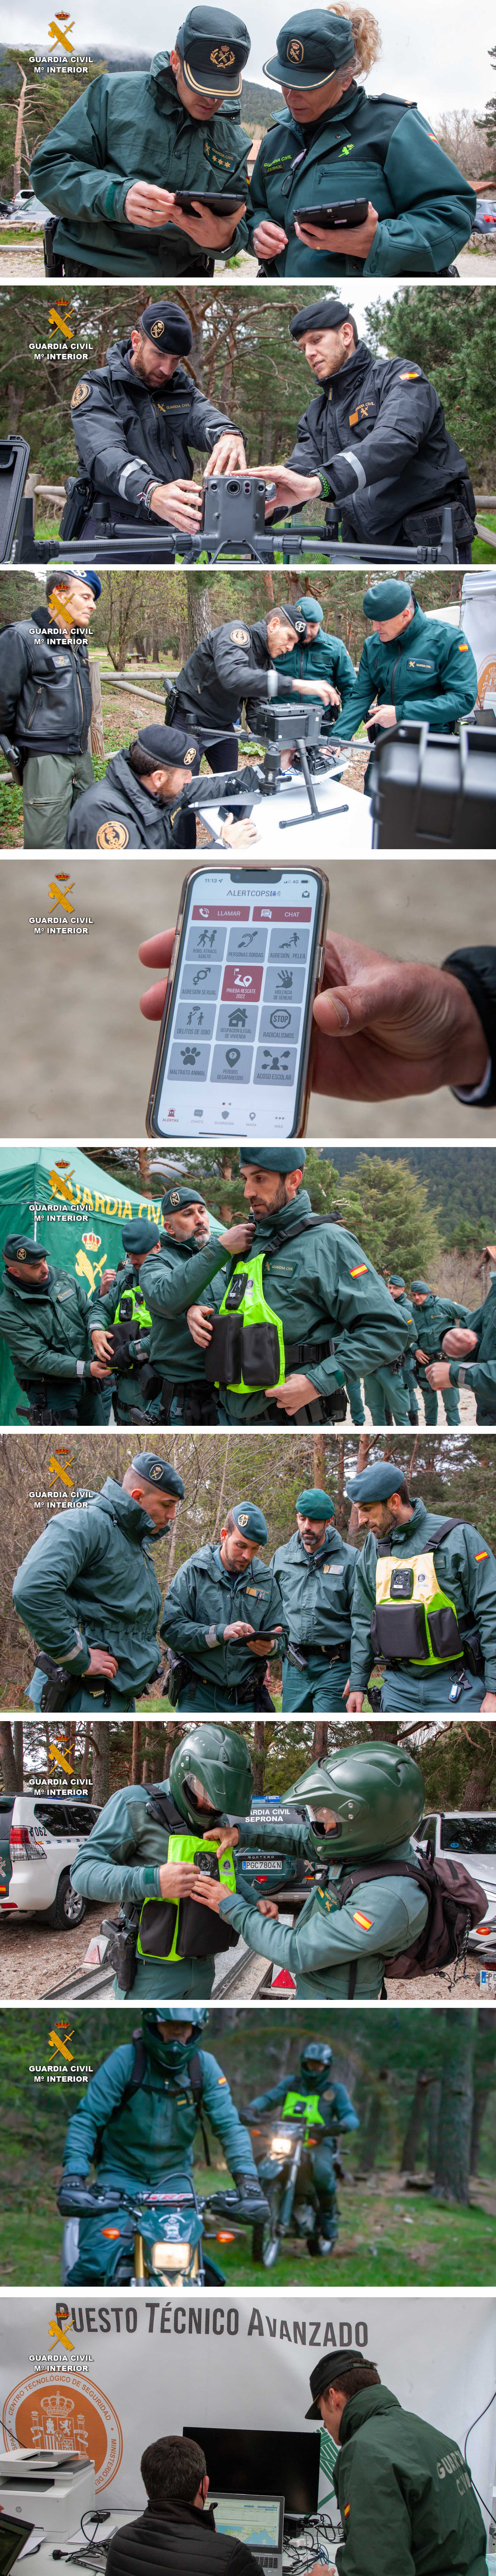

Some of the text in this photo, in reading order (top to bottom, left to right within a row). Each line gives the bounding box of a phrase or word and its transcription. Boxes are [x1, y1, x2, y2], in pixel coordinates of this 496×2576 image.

[212, 148, 224, 158] GUARDIA
[138, 1204, 165, 1226] CIVI
[34, 1827, 47, 1836] 062
[56, 2302, 368, 2347] PUESTO TÉCNICO AVANZADO
[8, 2375, 111, 2421] CENTRO TECNOLÓGICO DE SEGURIDAD
[8, 2428, 17, 2450] SPAÑA
[102, 2439, 116, 2476] MINISTERIO
[437, 2451, 466, 2479] GUARDI
